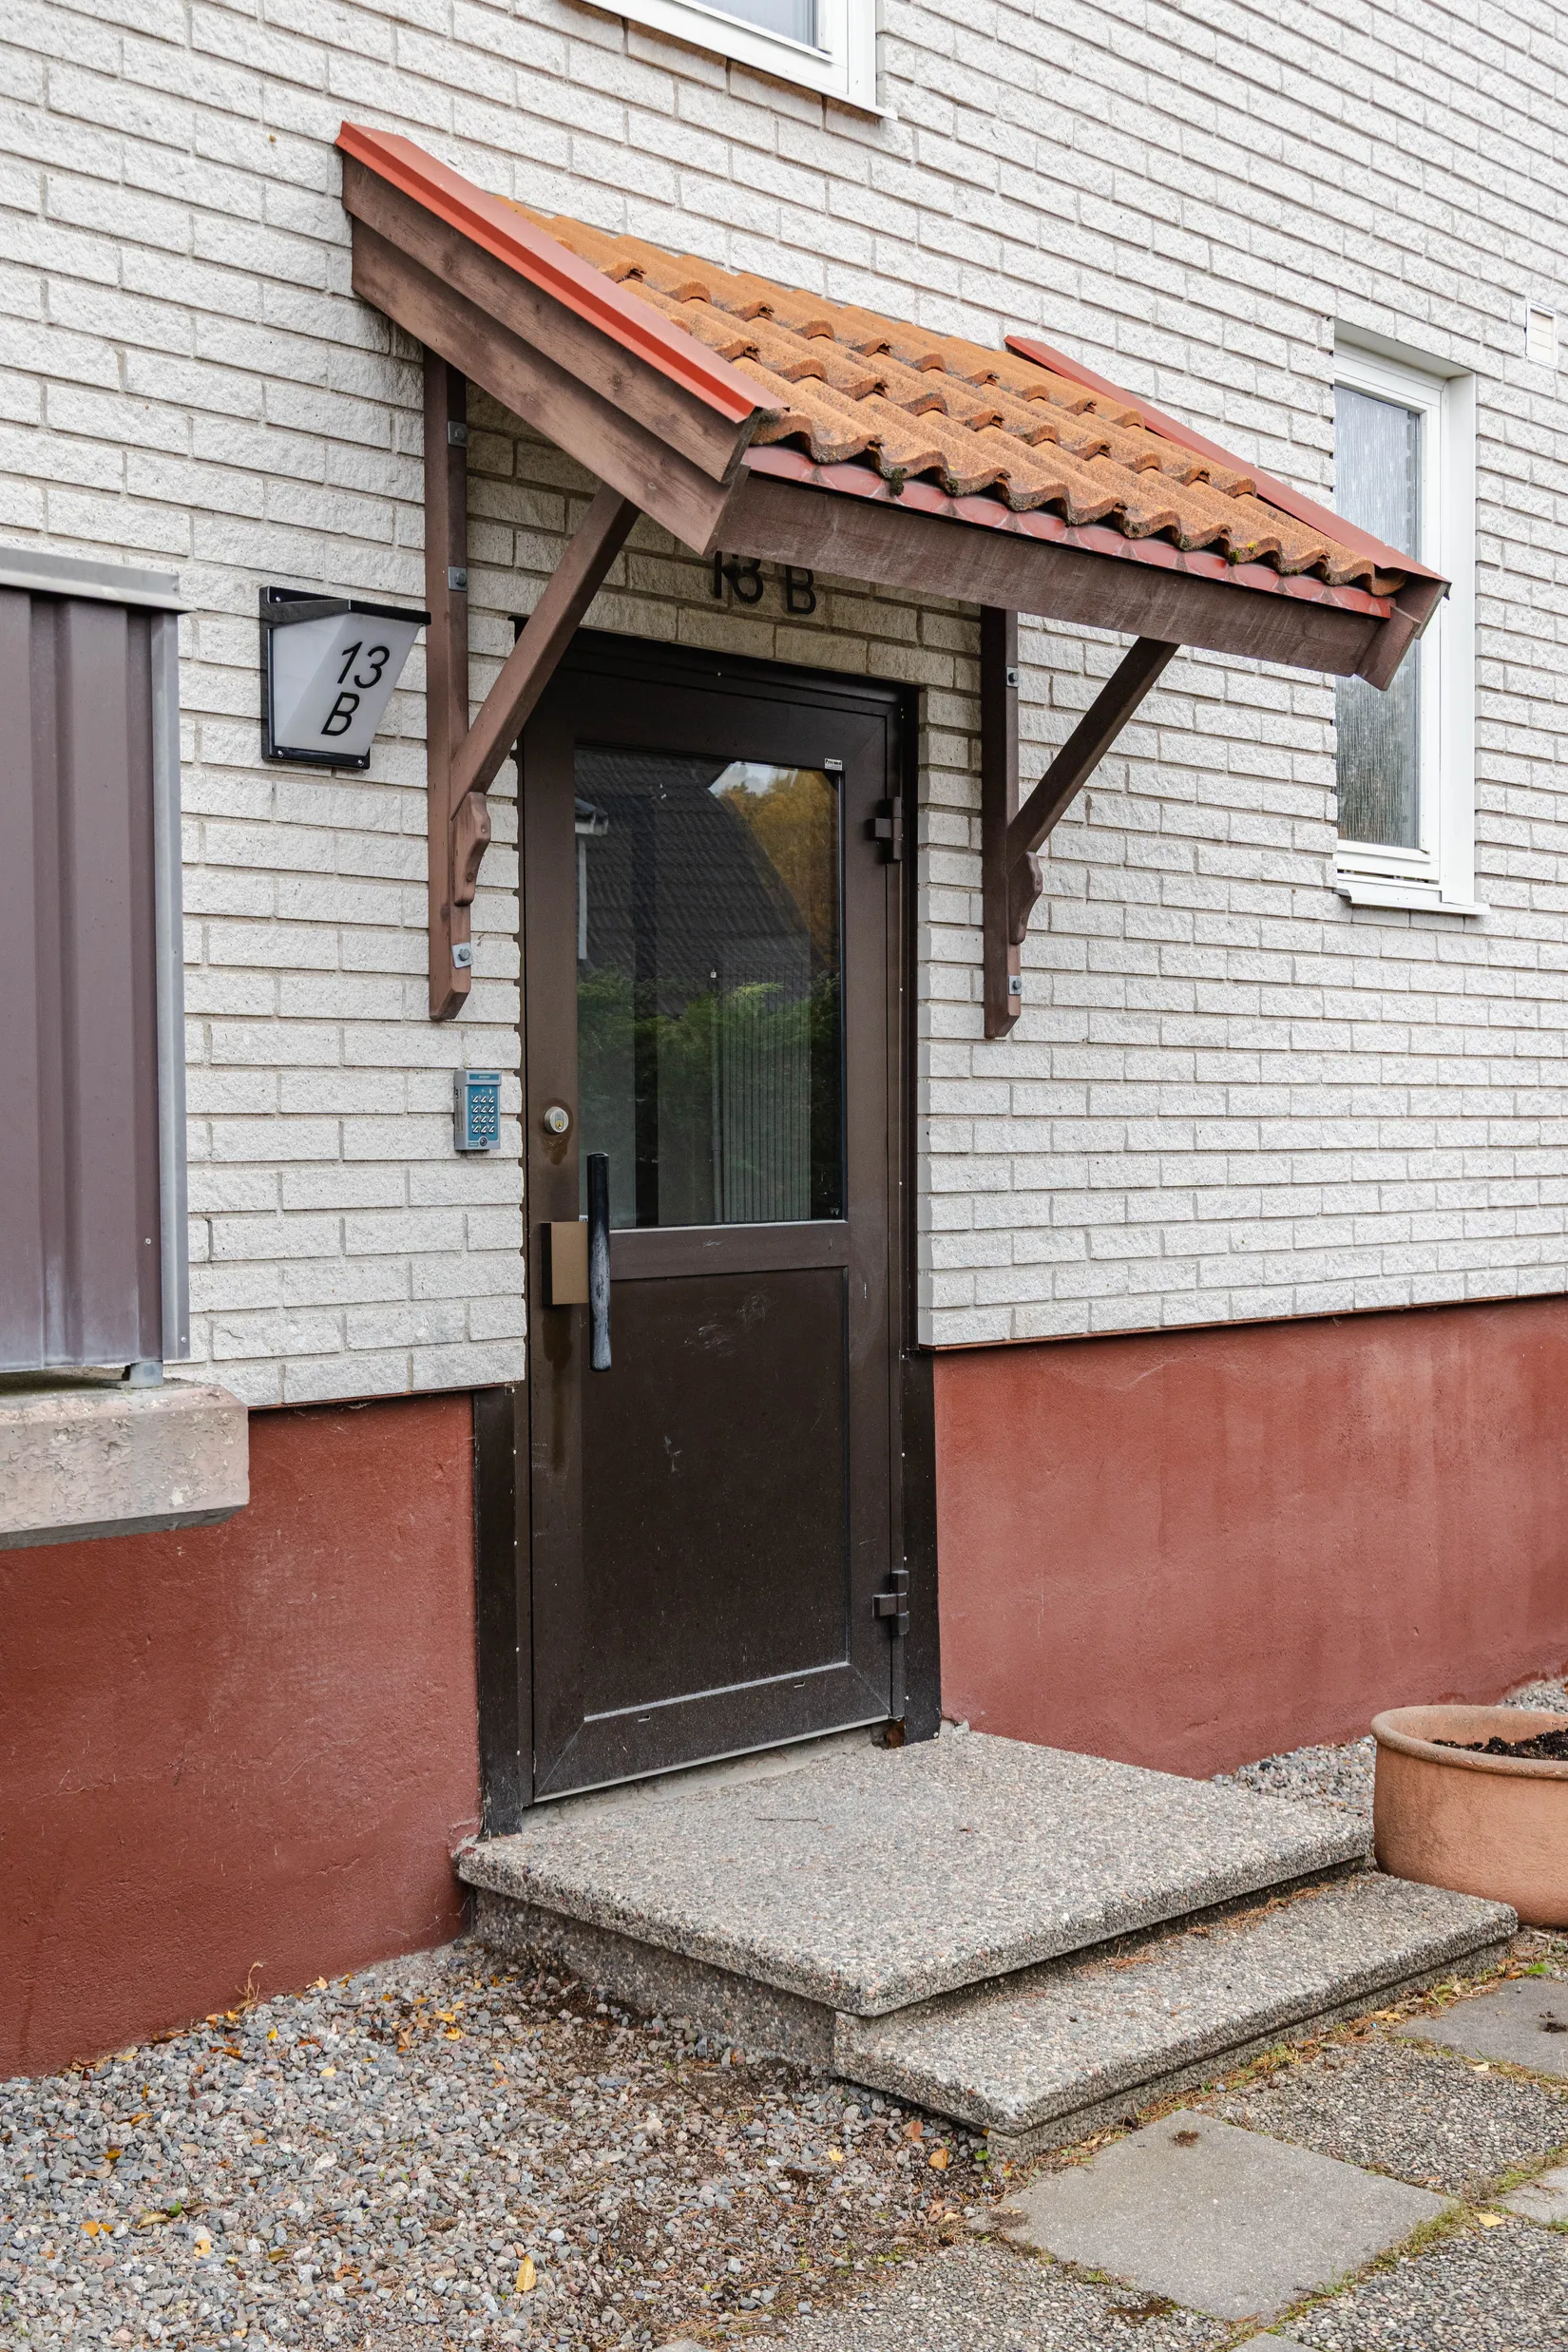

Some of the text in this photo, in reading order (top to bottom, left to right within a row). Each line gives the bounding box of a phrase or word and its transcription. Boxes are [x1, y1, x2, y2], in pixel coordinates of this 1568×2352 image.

[786, 564, 817, 615] B
[337, 641, 391, 689] 13
[320, 691, 360, 736] B
